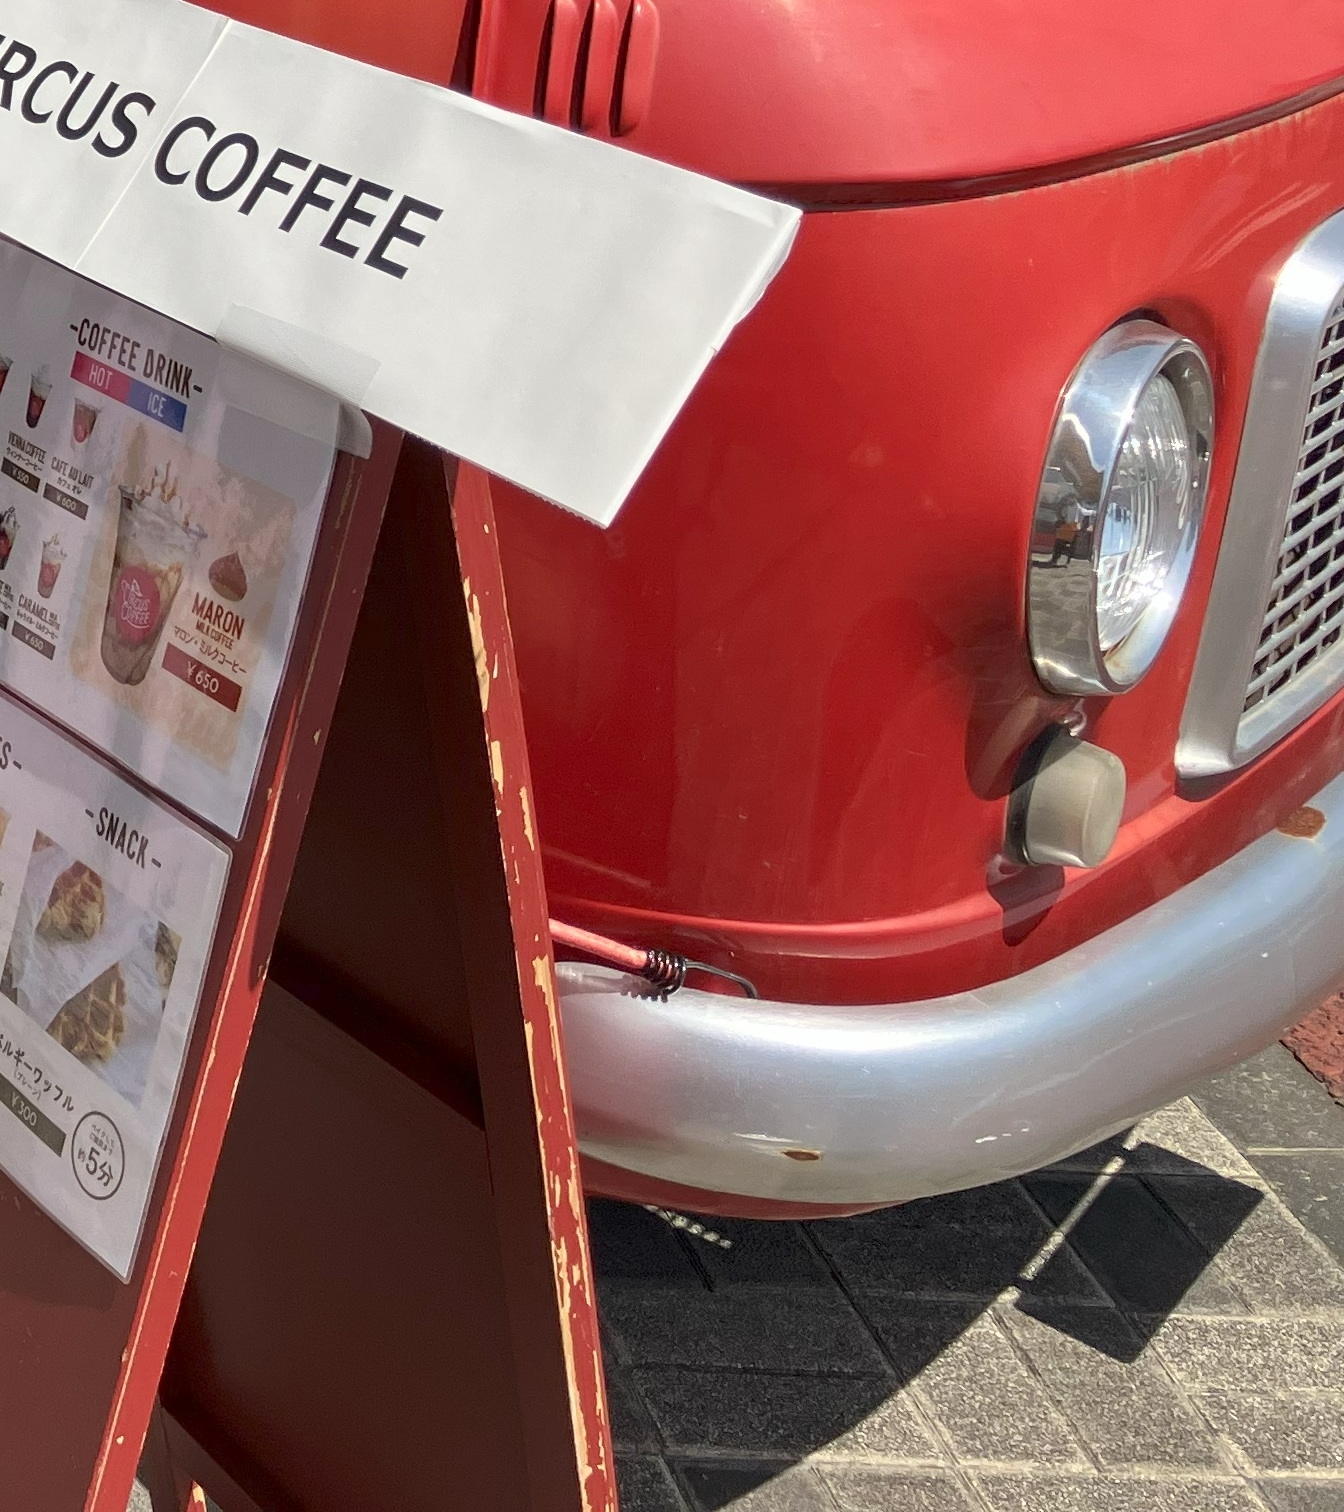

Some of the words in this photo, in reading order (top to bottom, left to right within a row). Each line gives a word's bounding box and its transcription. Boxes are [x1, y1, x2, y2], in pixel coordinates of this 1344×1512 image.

[154, 116, 444, 280] COFFEE
[89, 363, 113, 390] HOT
[147, 392, 167, 418] ICE
[19, 593, 47, 621] CARAMEL
[192, 591, 245, 641] MARON
[209, 629, 234, 651] COFFEE
[187, 661, 220, 694] ¥650
[10, 1091, 38, 1126] ¥300
